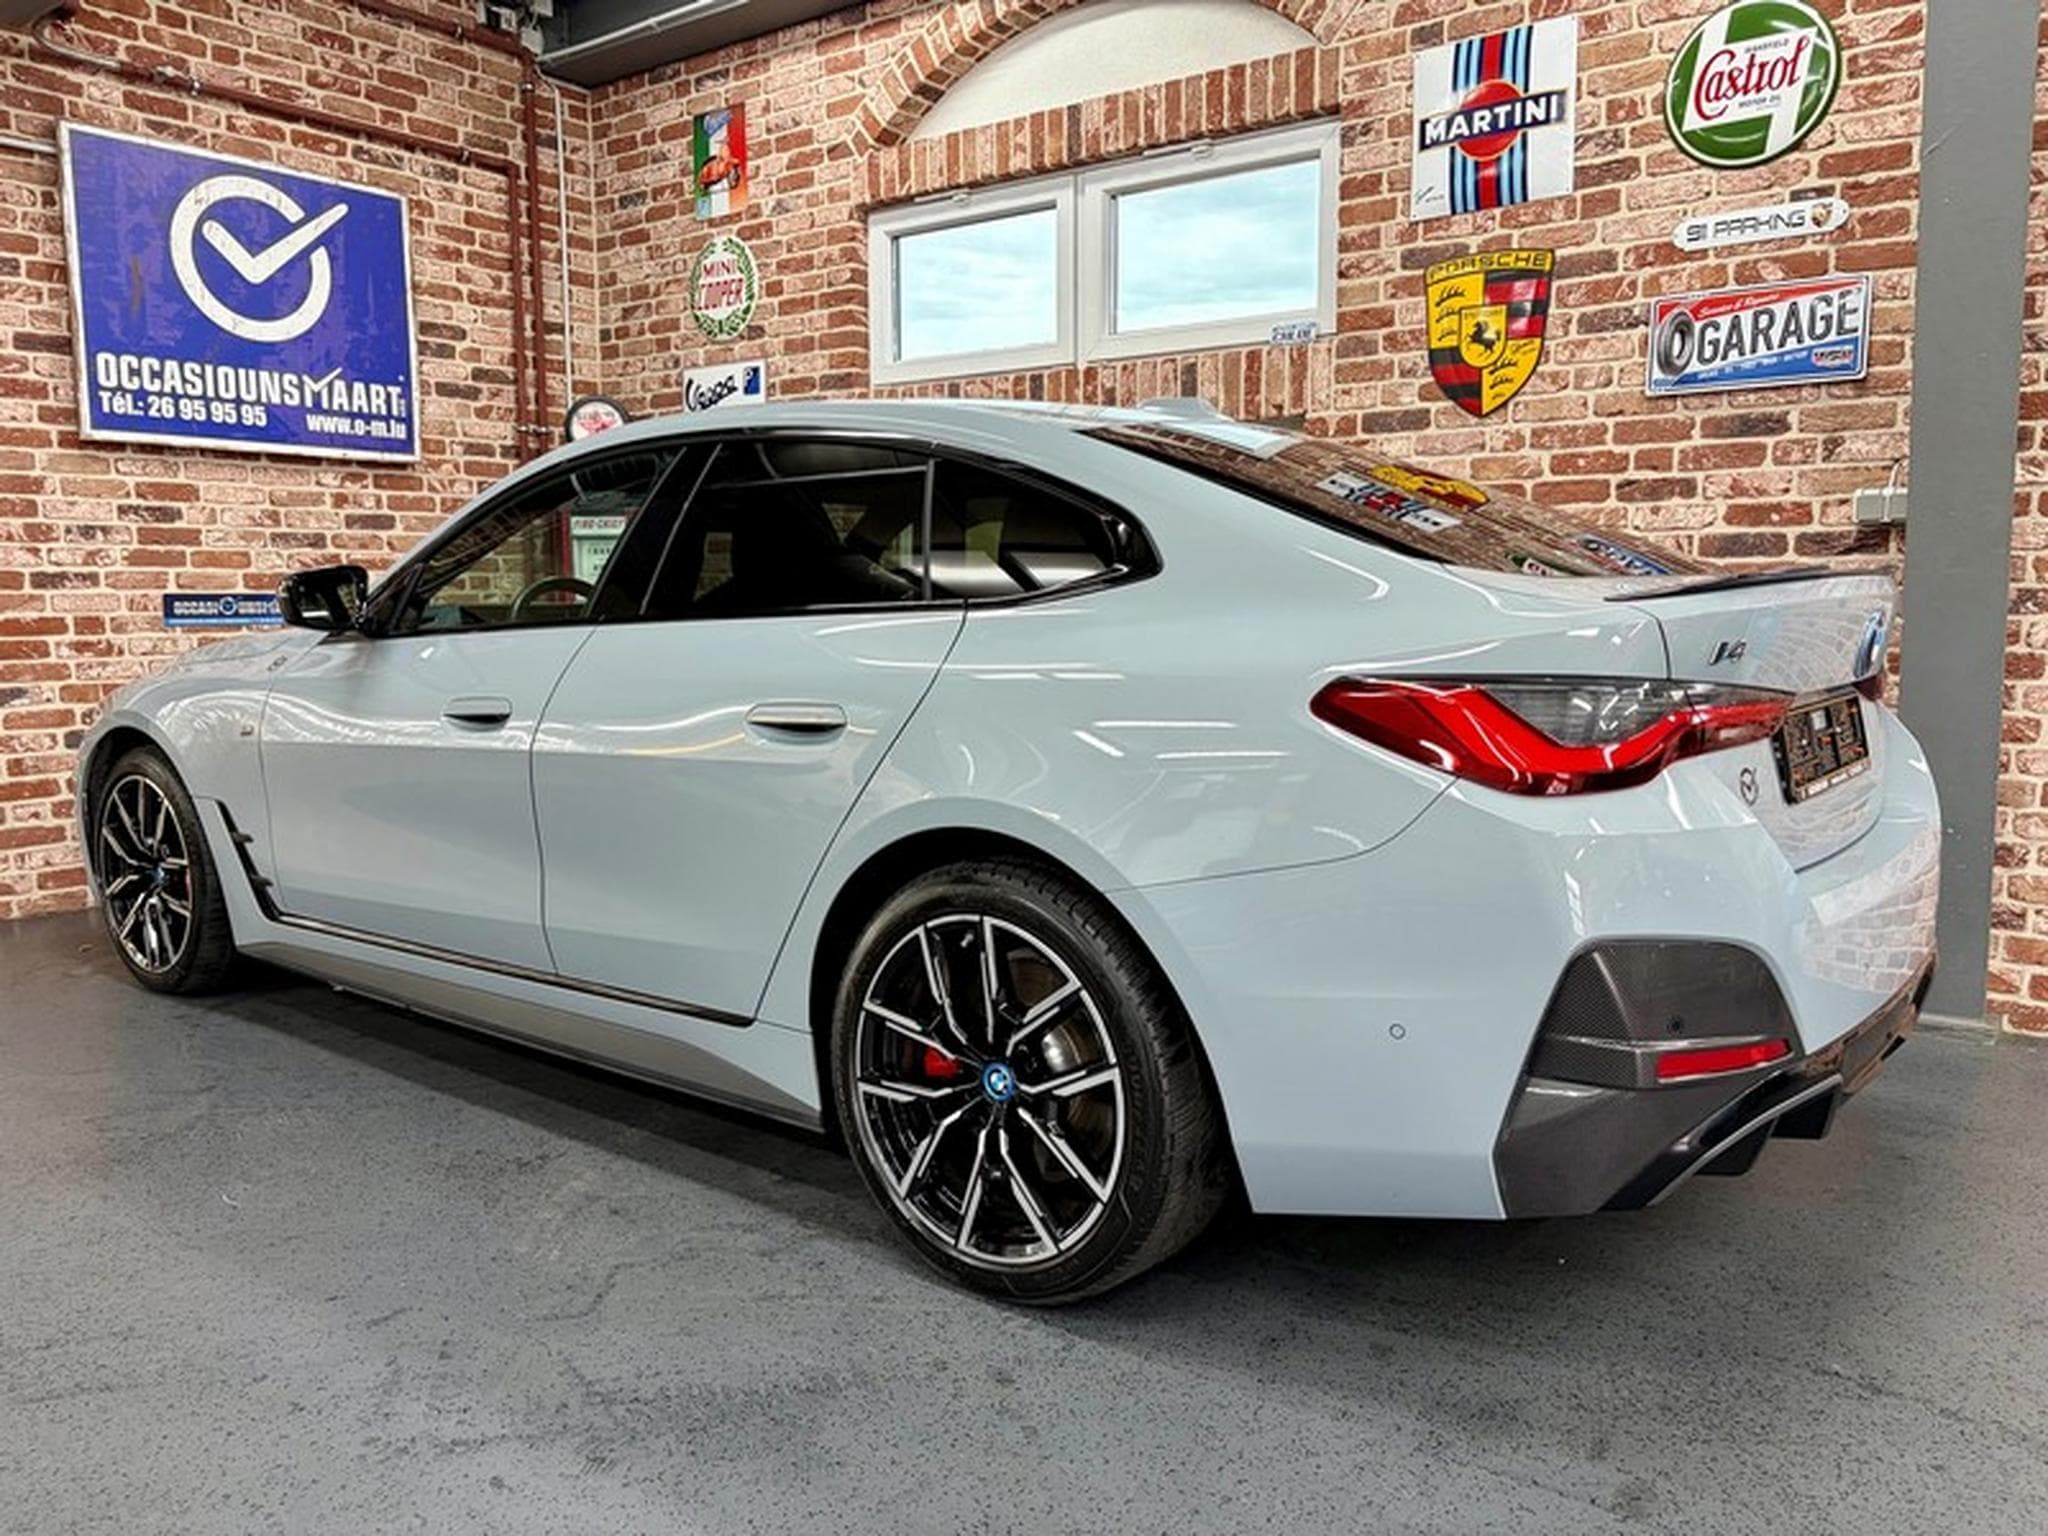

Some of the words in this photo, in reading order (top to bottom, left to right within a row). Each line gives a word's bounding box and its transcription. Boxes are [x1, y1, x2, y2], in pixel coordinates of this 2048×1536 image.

[1694, 35, 1811, 121] Castrol
[1424, 93, 1559, 147] MARTINI
[1713, 209, 1806, 238] PARKING
[703, 258, 737, 279] MINI
[1429, 251, 1548, 281] PORSCHE
[696, 278, 744, 311] COOPER
[1696, 289, 1861, 367] GARAGE
[686, 375, 739, 413] Vespa
[147, 395, 176, 419] 26
[178, 398, 207, 422] 95
[210, 401, 238, 424] 95
[240, 404, 267, 428] 95
[305, 413, 407, 440] www.o-m.lu
